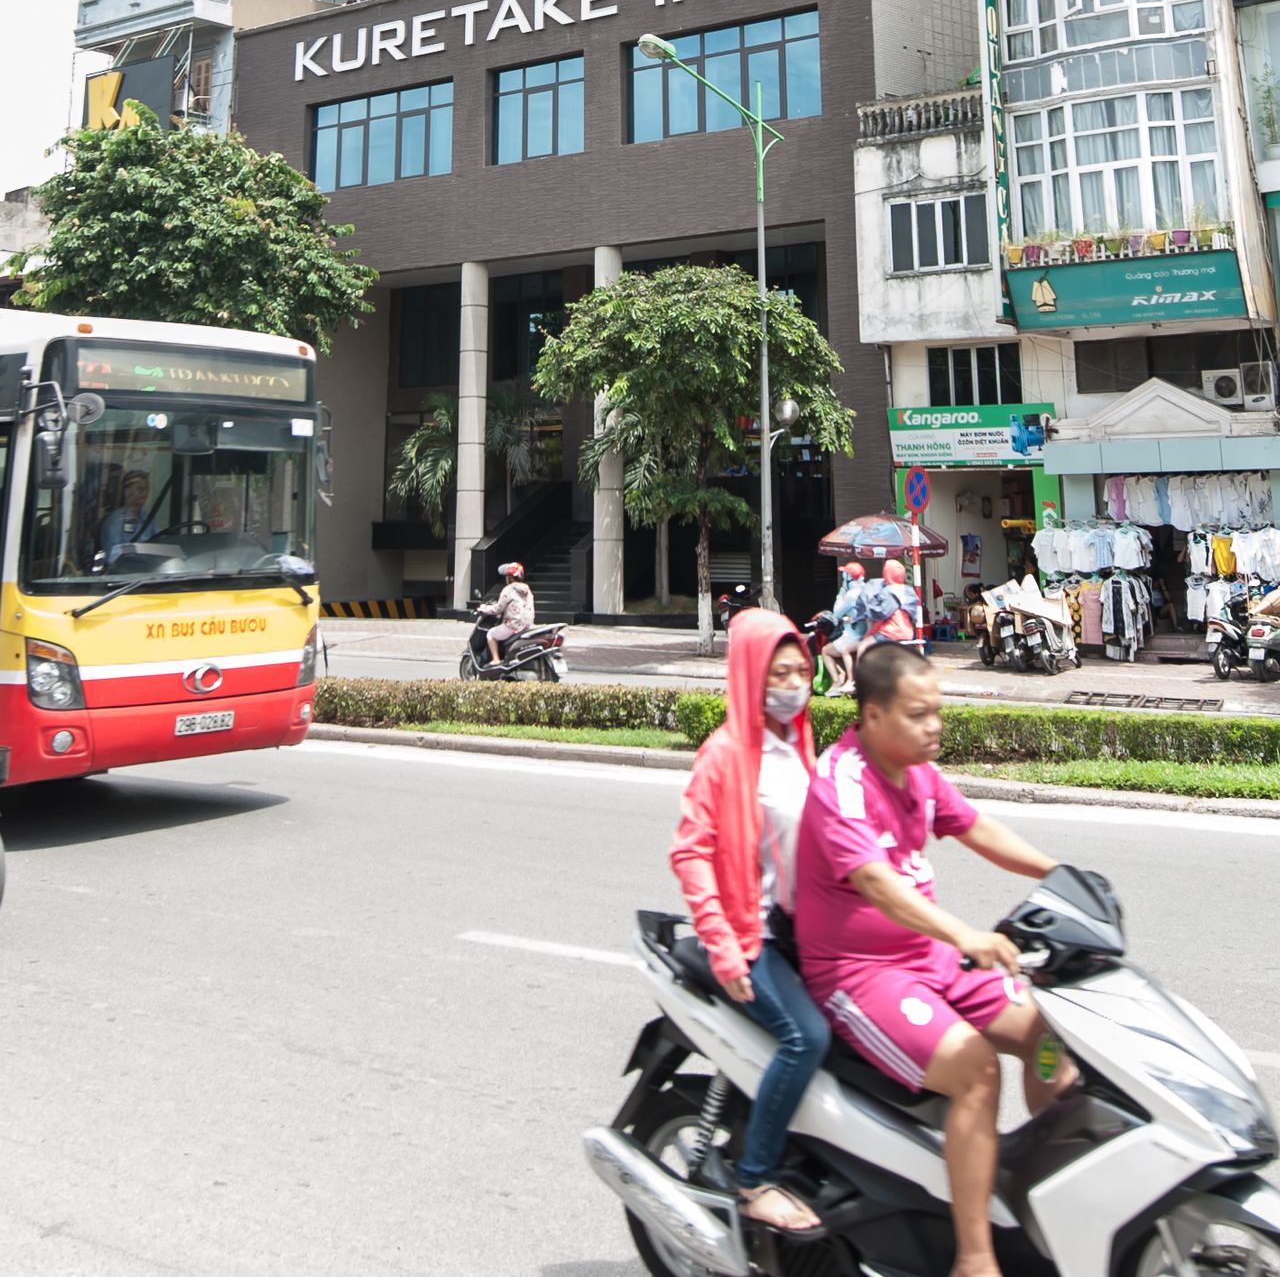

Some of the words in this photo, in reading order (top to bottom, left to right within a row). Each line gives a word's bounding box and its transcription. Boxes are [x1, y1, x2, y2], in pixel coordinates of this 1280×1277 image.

[897, 410, 980, 428] Kangaroo
[896, 444, 925, 452] THANH
[172, 621, 195, 637] BUS
